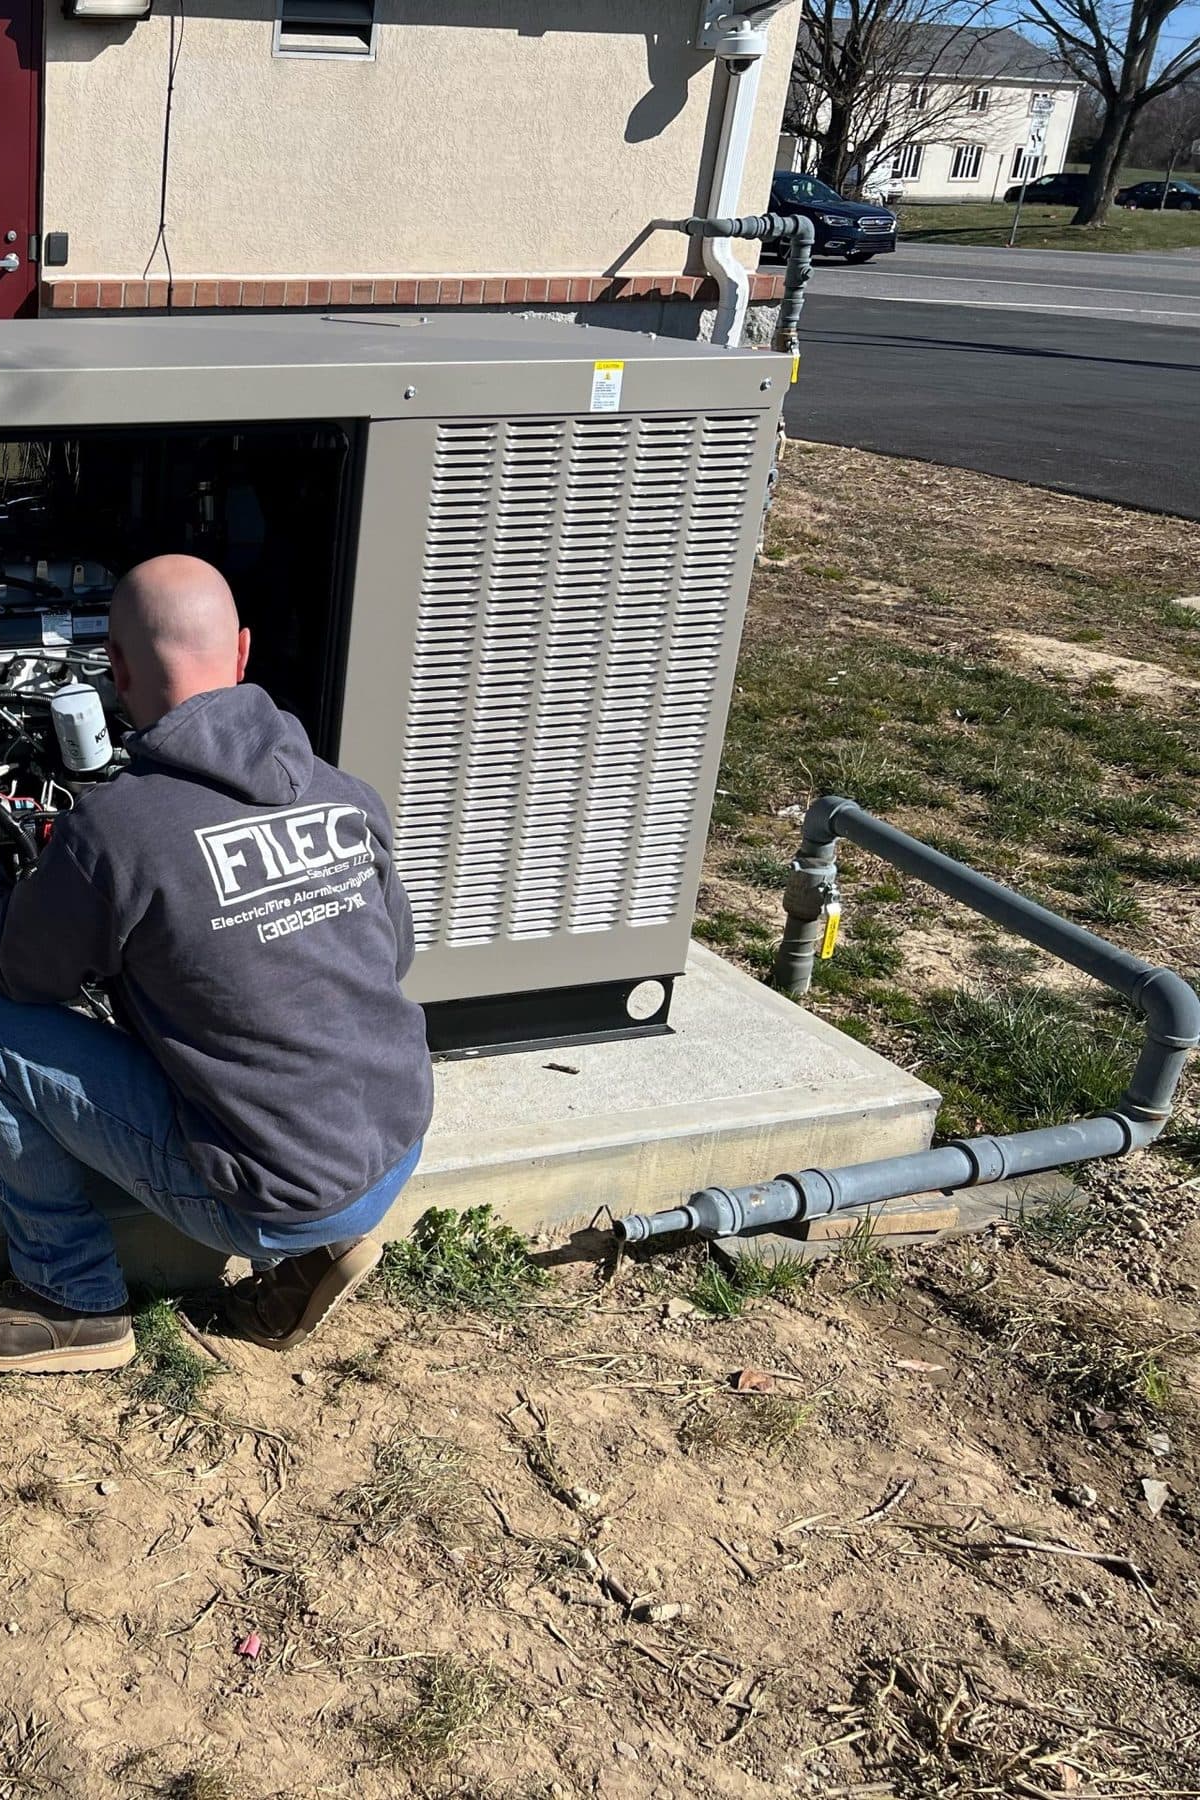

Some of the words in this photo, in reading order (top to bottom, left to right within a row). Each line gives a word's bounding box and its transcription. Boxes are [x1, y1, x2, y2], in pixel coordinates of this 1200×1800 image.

[205, 806, 367, 894] FILEC
[353, 853, 370, 867] LLC
[210, 897, 291, 931] Electric/Fire
